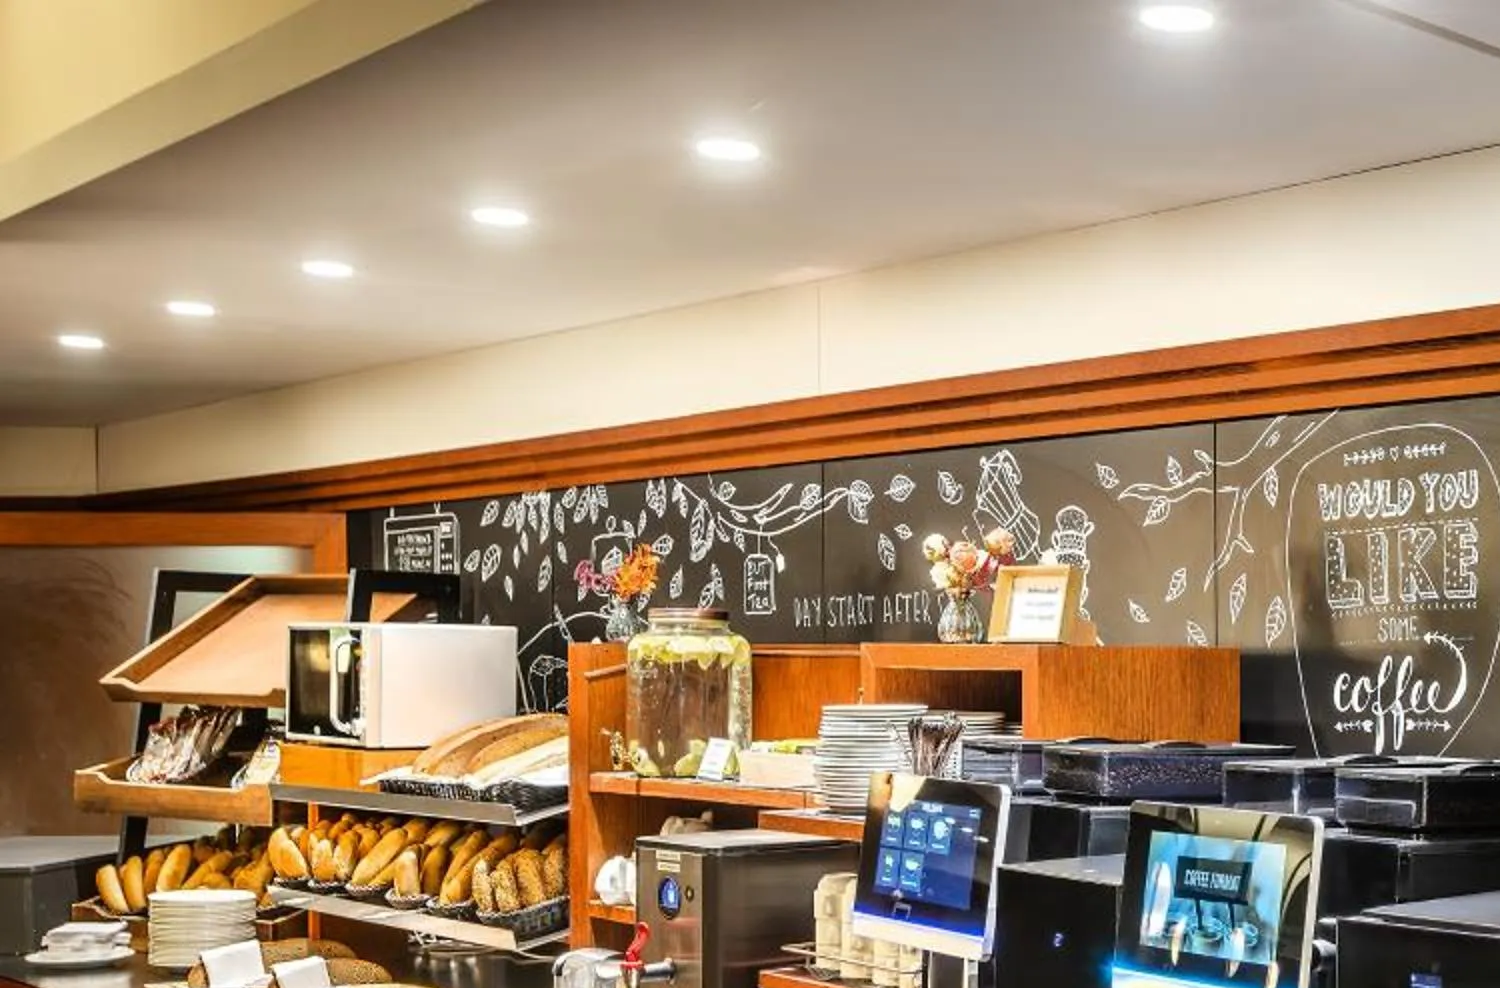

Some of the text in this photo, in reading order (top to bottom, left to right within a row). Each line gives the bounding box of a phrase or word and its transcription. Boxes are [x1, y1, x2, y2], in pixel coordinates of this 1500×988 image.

[1317, 468, 1479, 521] WOULD YOU
[1325, 520, 1479, 609] LIKE
[793, 597, 822, 628] DAY
[827, 592, 875, 628] START
[883, 589, 933, 625] AFTER
[1377, 615, 1419, 643] SOME
[1333, 655, 1467, 756] coffee
